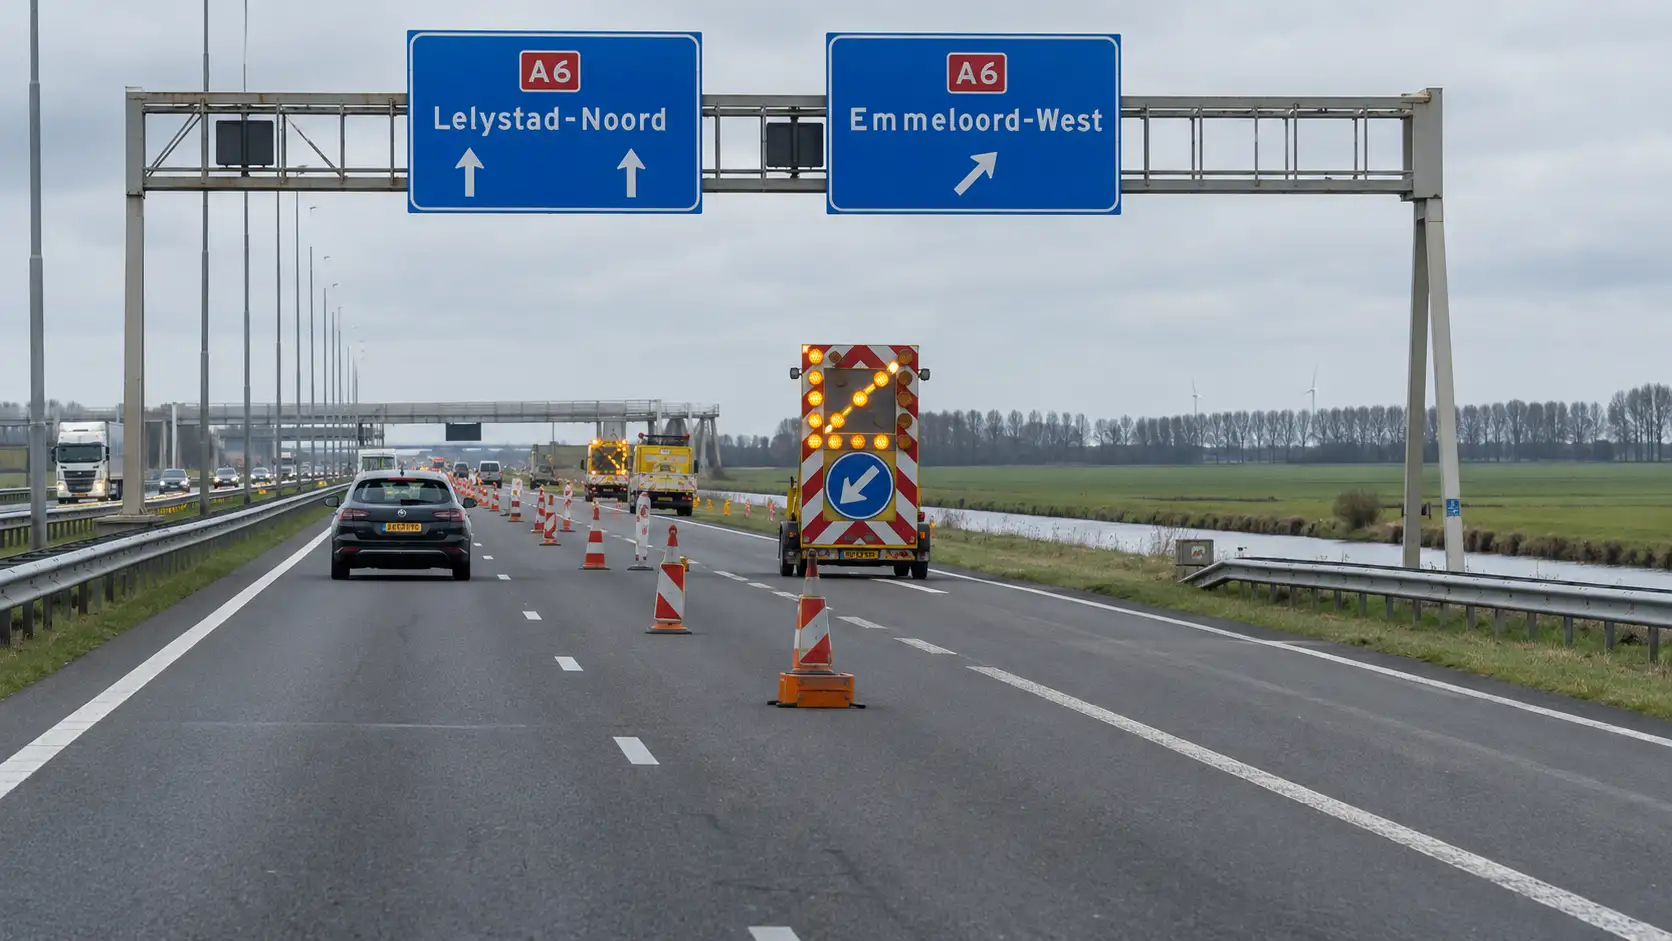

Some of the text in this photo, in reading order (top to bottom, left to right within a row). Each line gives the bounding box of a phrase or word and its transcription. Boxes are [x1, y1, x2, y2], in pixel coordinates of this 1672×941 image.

[529, 61, 572, 83] A6
[956, 62, 998, 84] A6
[434, 106, 667, 136] Lelystad-Noord
[850, 107, 1103, 131] Emmeloord-West
